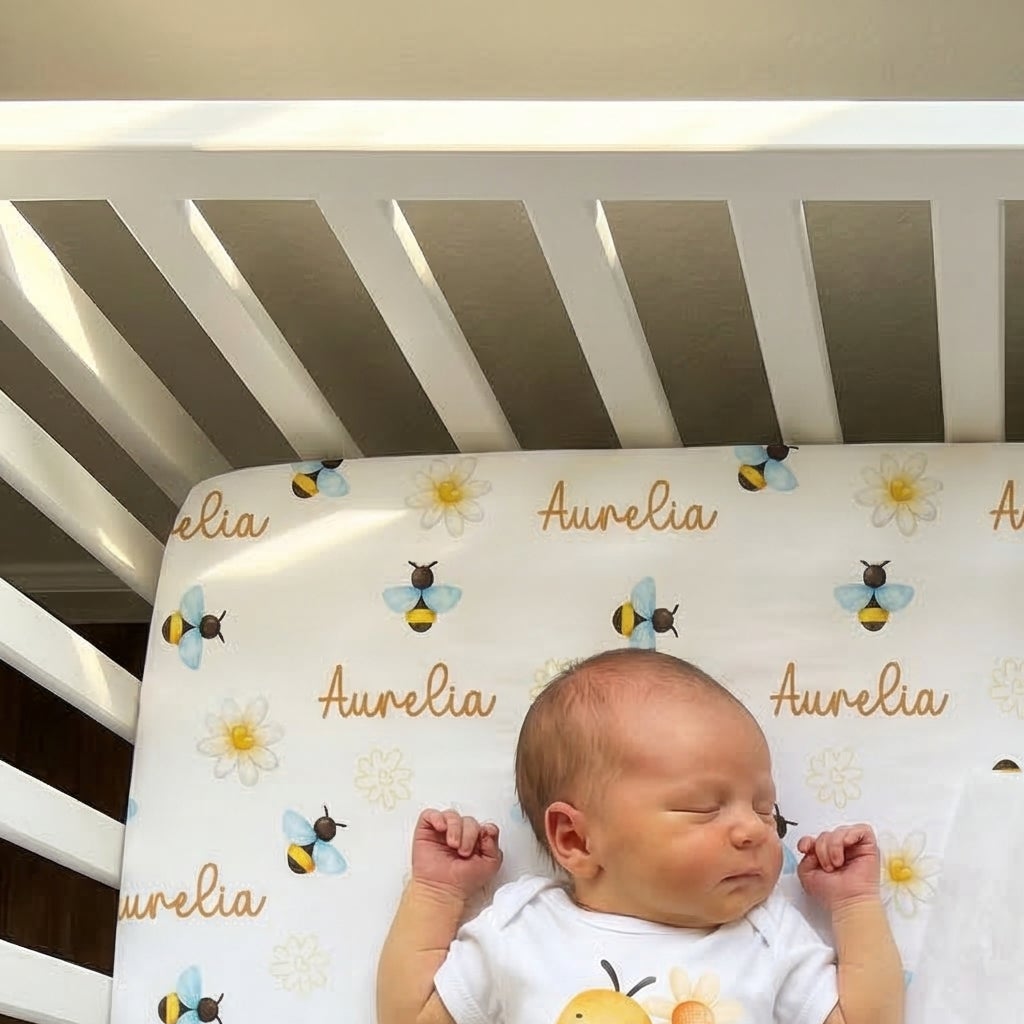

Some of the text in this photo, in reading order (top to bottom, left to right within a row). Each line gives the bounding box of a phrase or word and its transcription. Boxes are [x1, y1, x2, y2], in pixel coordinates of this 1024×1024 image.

[171, 489, 270, 541] elia
[538, 479, 718, 533] Aurelia
[318, 662, 497, 719] Aurelia
[770, 661, 949, 717] Aurelia
[118, 862, 267, 921] urelia
